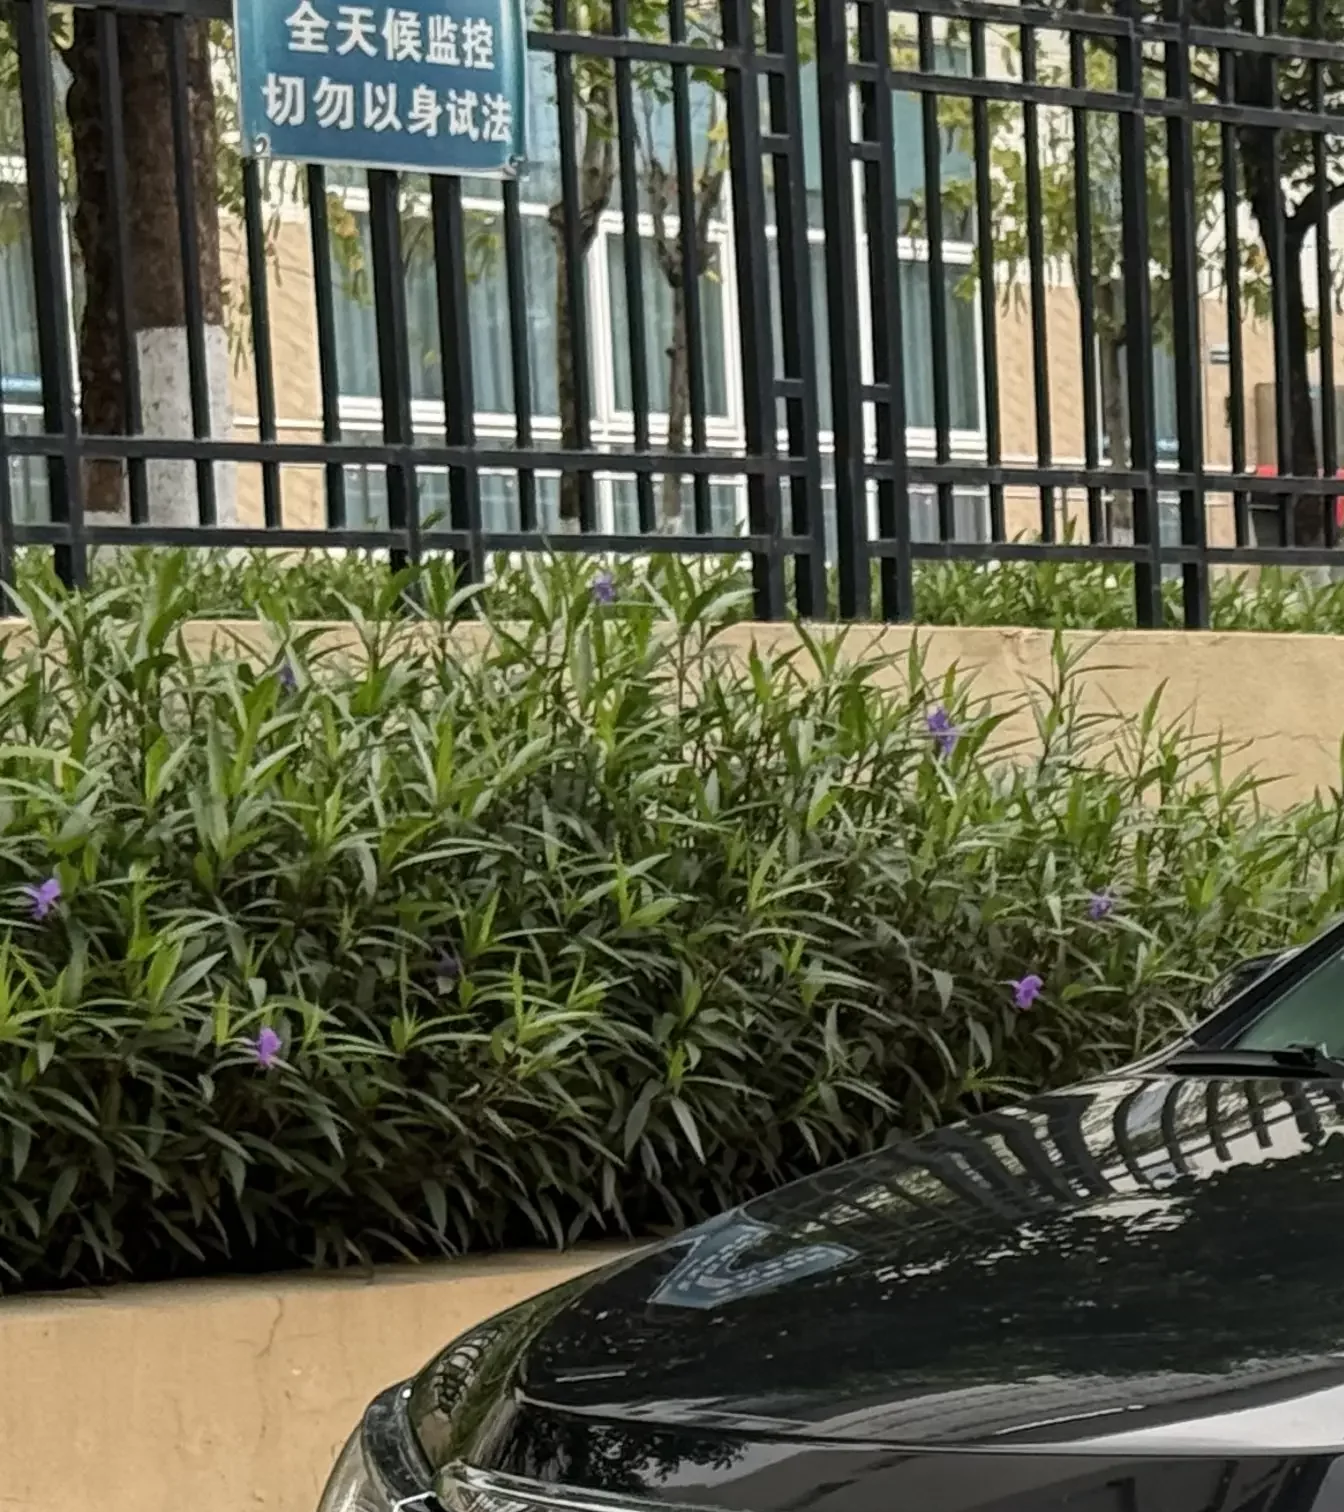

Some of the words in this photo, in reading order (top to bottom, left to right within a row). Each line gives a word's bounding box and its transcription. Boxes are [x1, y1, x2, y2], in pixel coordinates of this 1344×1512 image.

[285, 1, 495, 69] 全天候监控
[261, 72, 513, 142] 切勿以身试法
